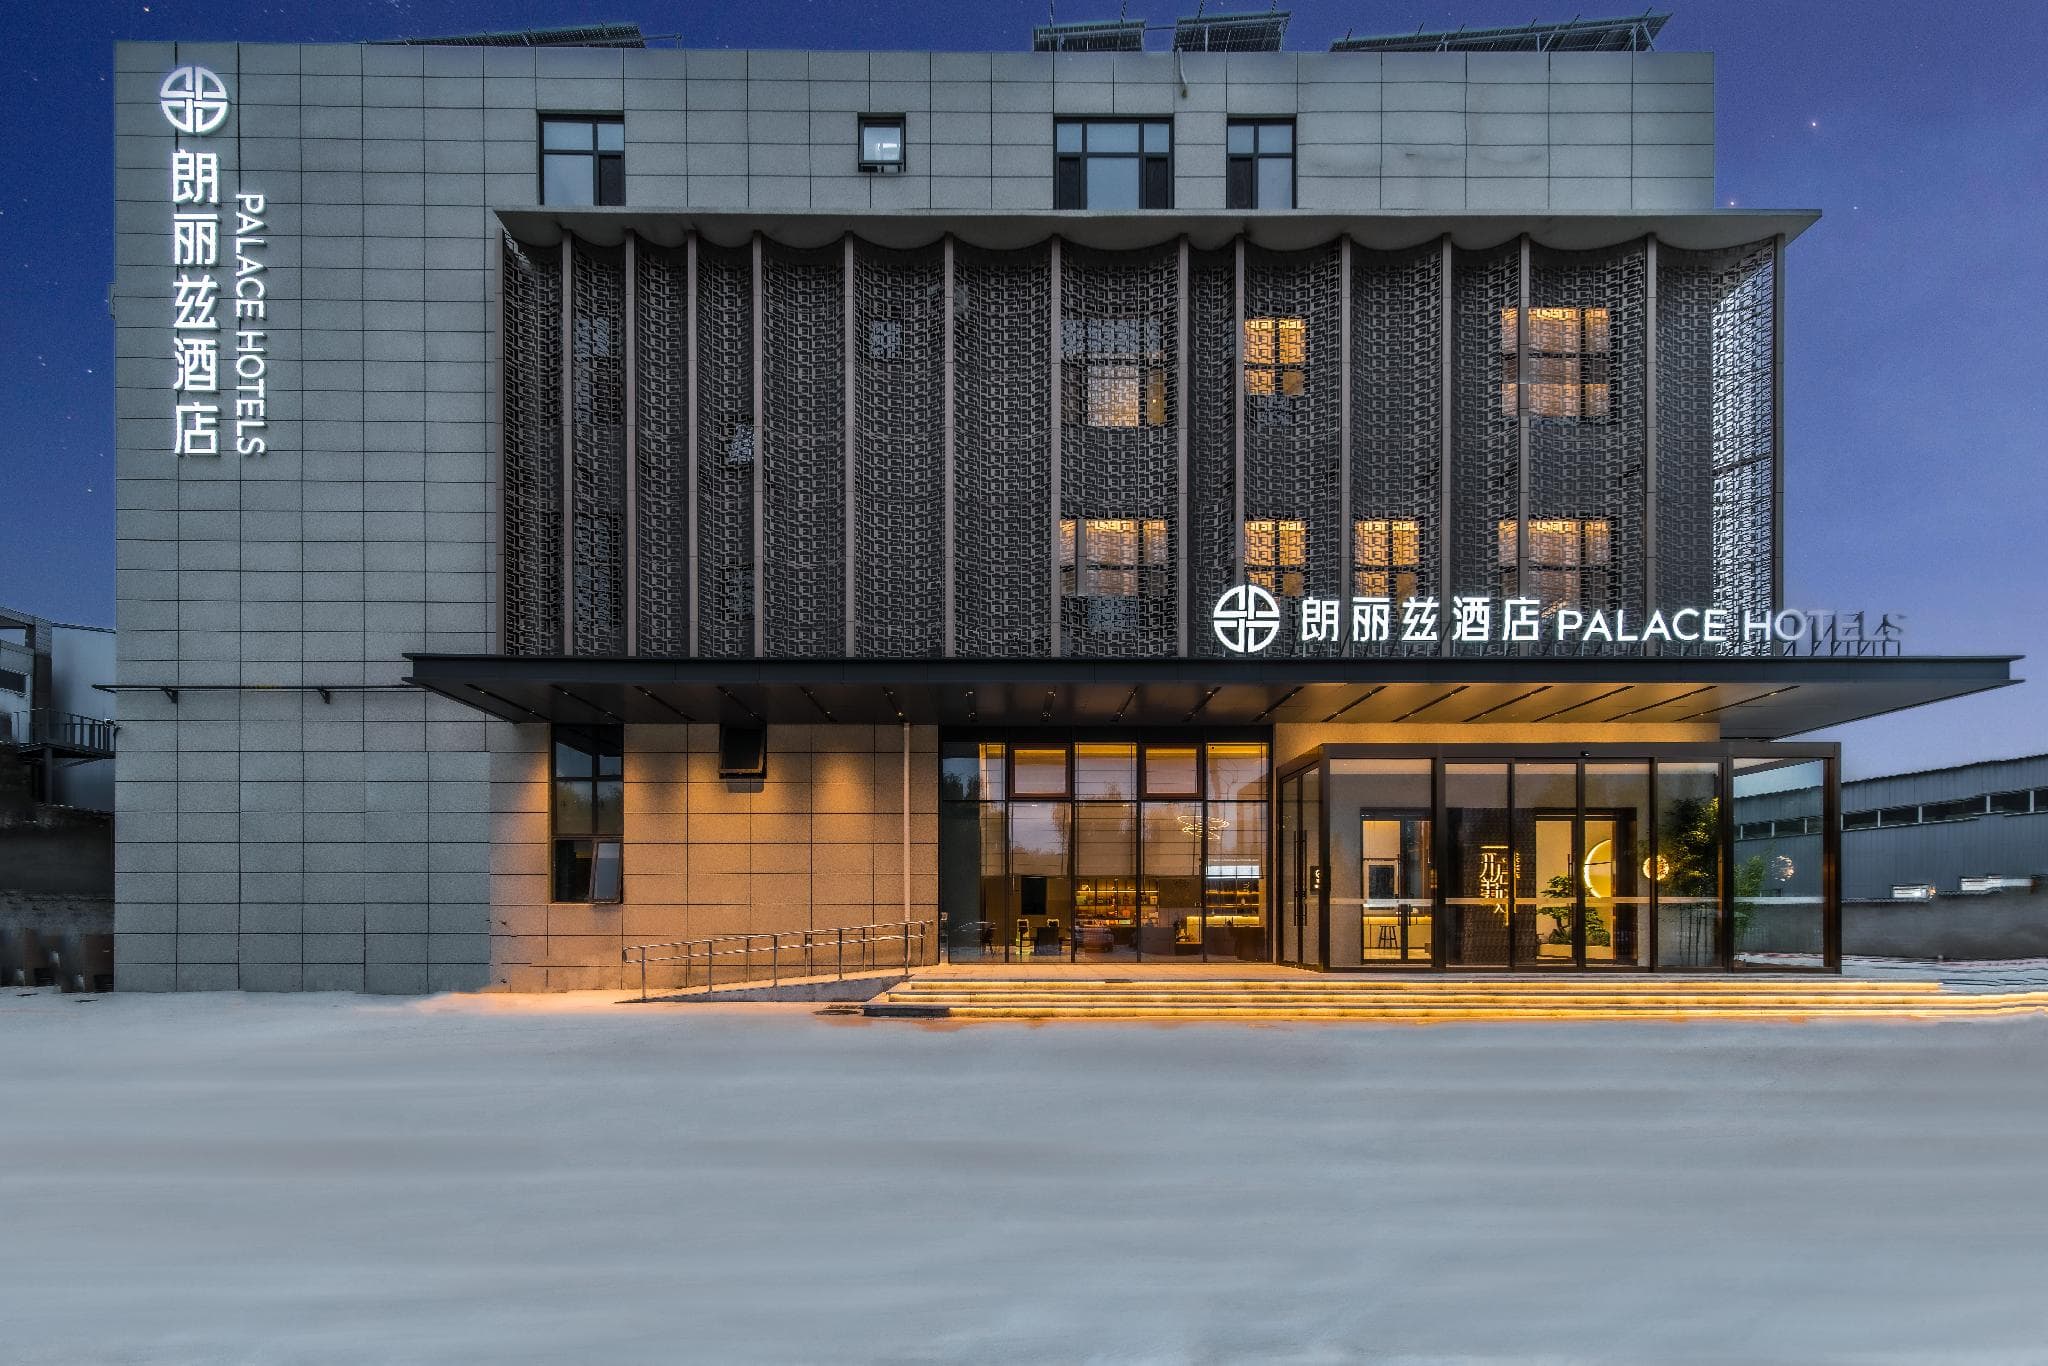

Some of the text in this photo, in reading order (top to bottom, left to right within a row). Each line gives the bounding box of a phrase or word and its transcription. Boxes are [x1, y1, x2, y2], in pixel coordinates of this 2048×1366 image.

[172, 149, 220, 456] 朗丽兹酒店
[234, 193, 267, 457] PALACE HOTELS
[1301, 596, 1540, 641] 朗丽兹酒店
[1556, 609, 1728, 640] PALACE
